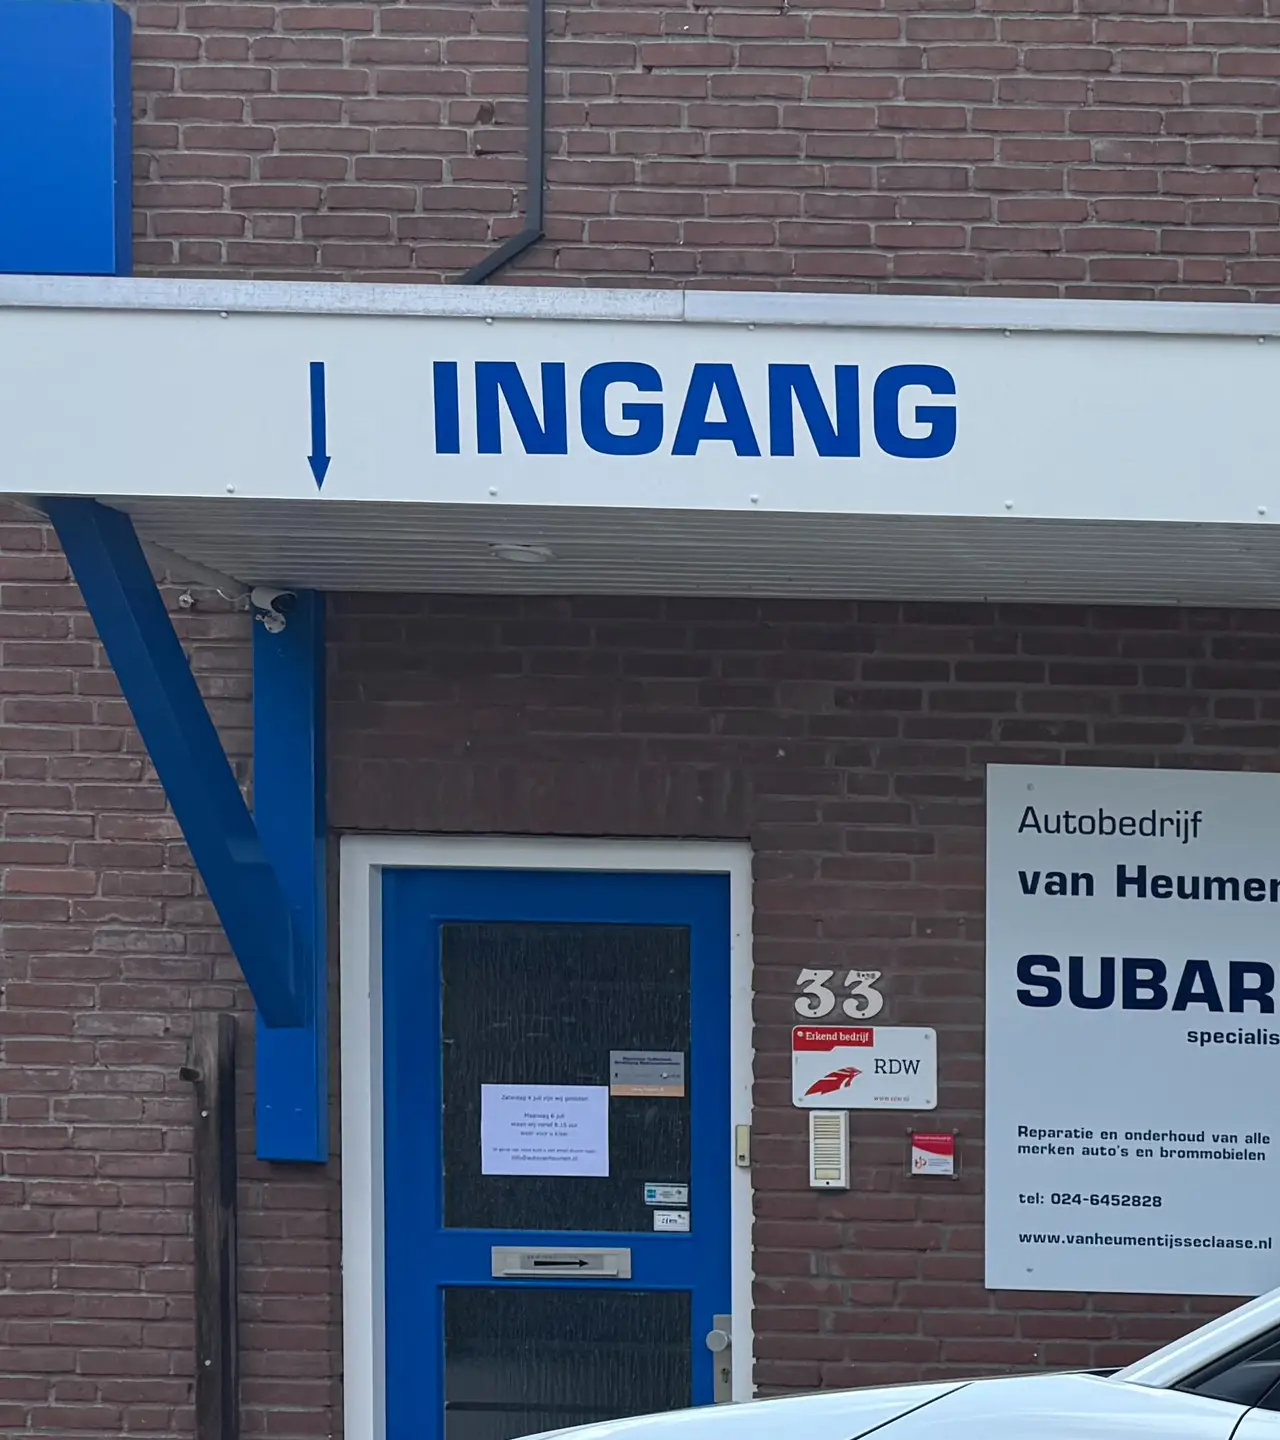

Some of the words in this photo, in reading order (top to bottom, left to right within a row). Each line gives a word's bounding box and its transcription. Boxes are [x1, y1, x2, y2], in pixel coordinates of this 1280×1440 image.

[432, 360, 957, 459] INGANG
[1017, 805, 1203, 845] Autobedrijf
[1018, 870, 1094, 897] van
[795, 968, 883, 1019] 33
[805, 1031, 839, 1041] Erkend
[839, 1031, 870, 1043] bedrijf
[873, 1058, 921, 1075] RDW
[1017, 1125, 1094, 1141] Reparatie
[1100, 1130, 1118, 1141] en
[1124, 1129, 1205, 1143] onderhoud
[1211, 1134, 1238, 1144] van
[1244, 1132, 1271, 1145] alle
[1017, 1143, 1075, 1156] merken
[1081, 1144, 1129, 1157] auto's
[1135, 1148, 1154, 1158] en
[1159, 1146, 1266, 1161] brommobielen
[1018, 1192, 1044, 1205] tel:
[1050, 1192, 1162, 1208] 024-6452828
[1018, 1232, 1272, 1250] www.vanheumentijsseclaase.nl
